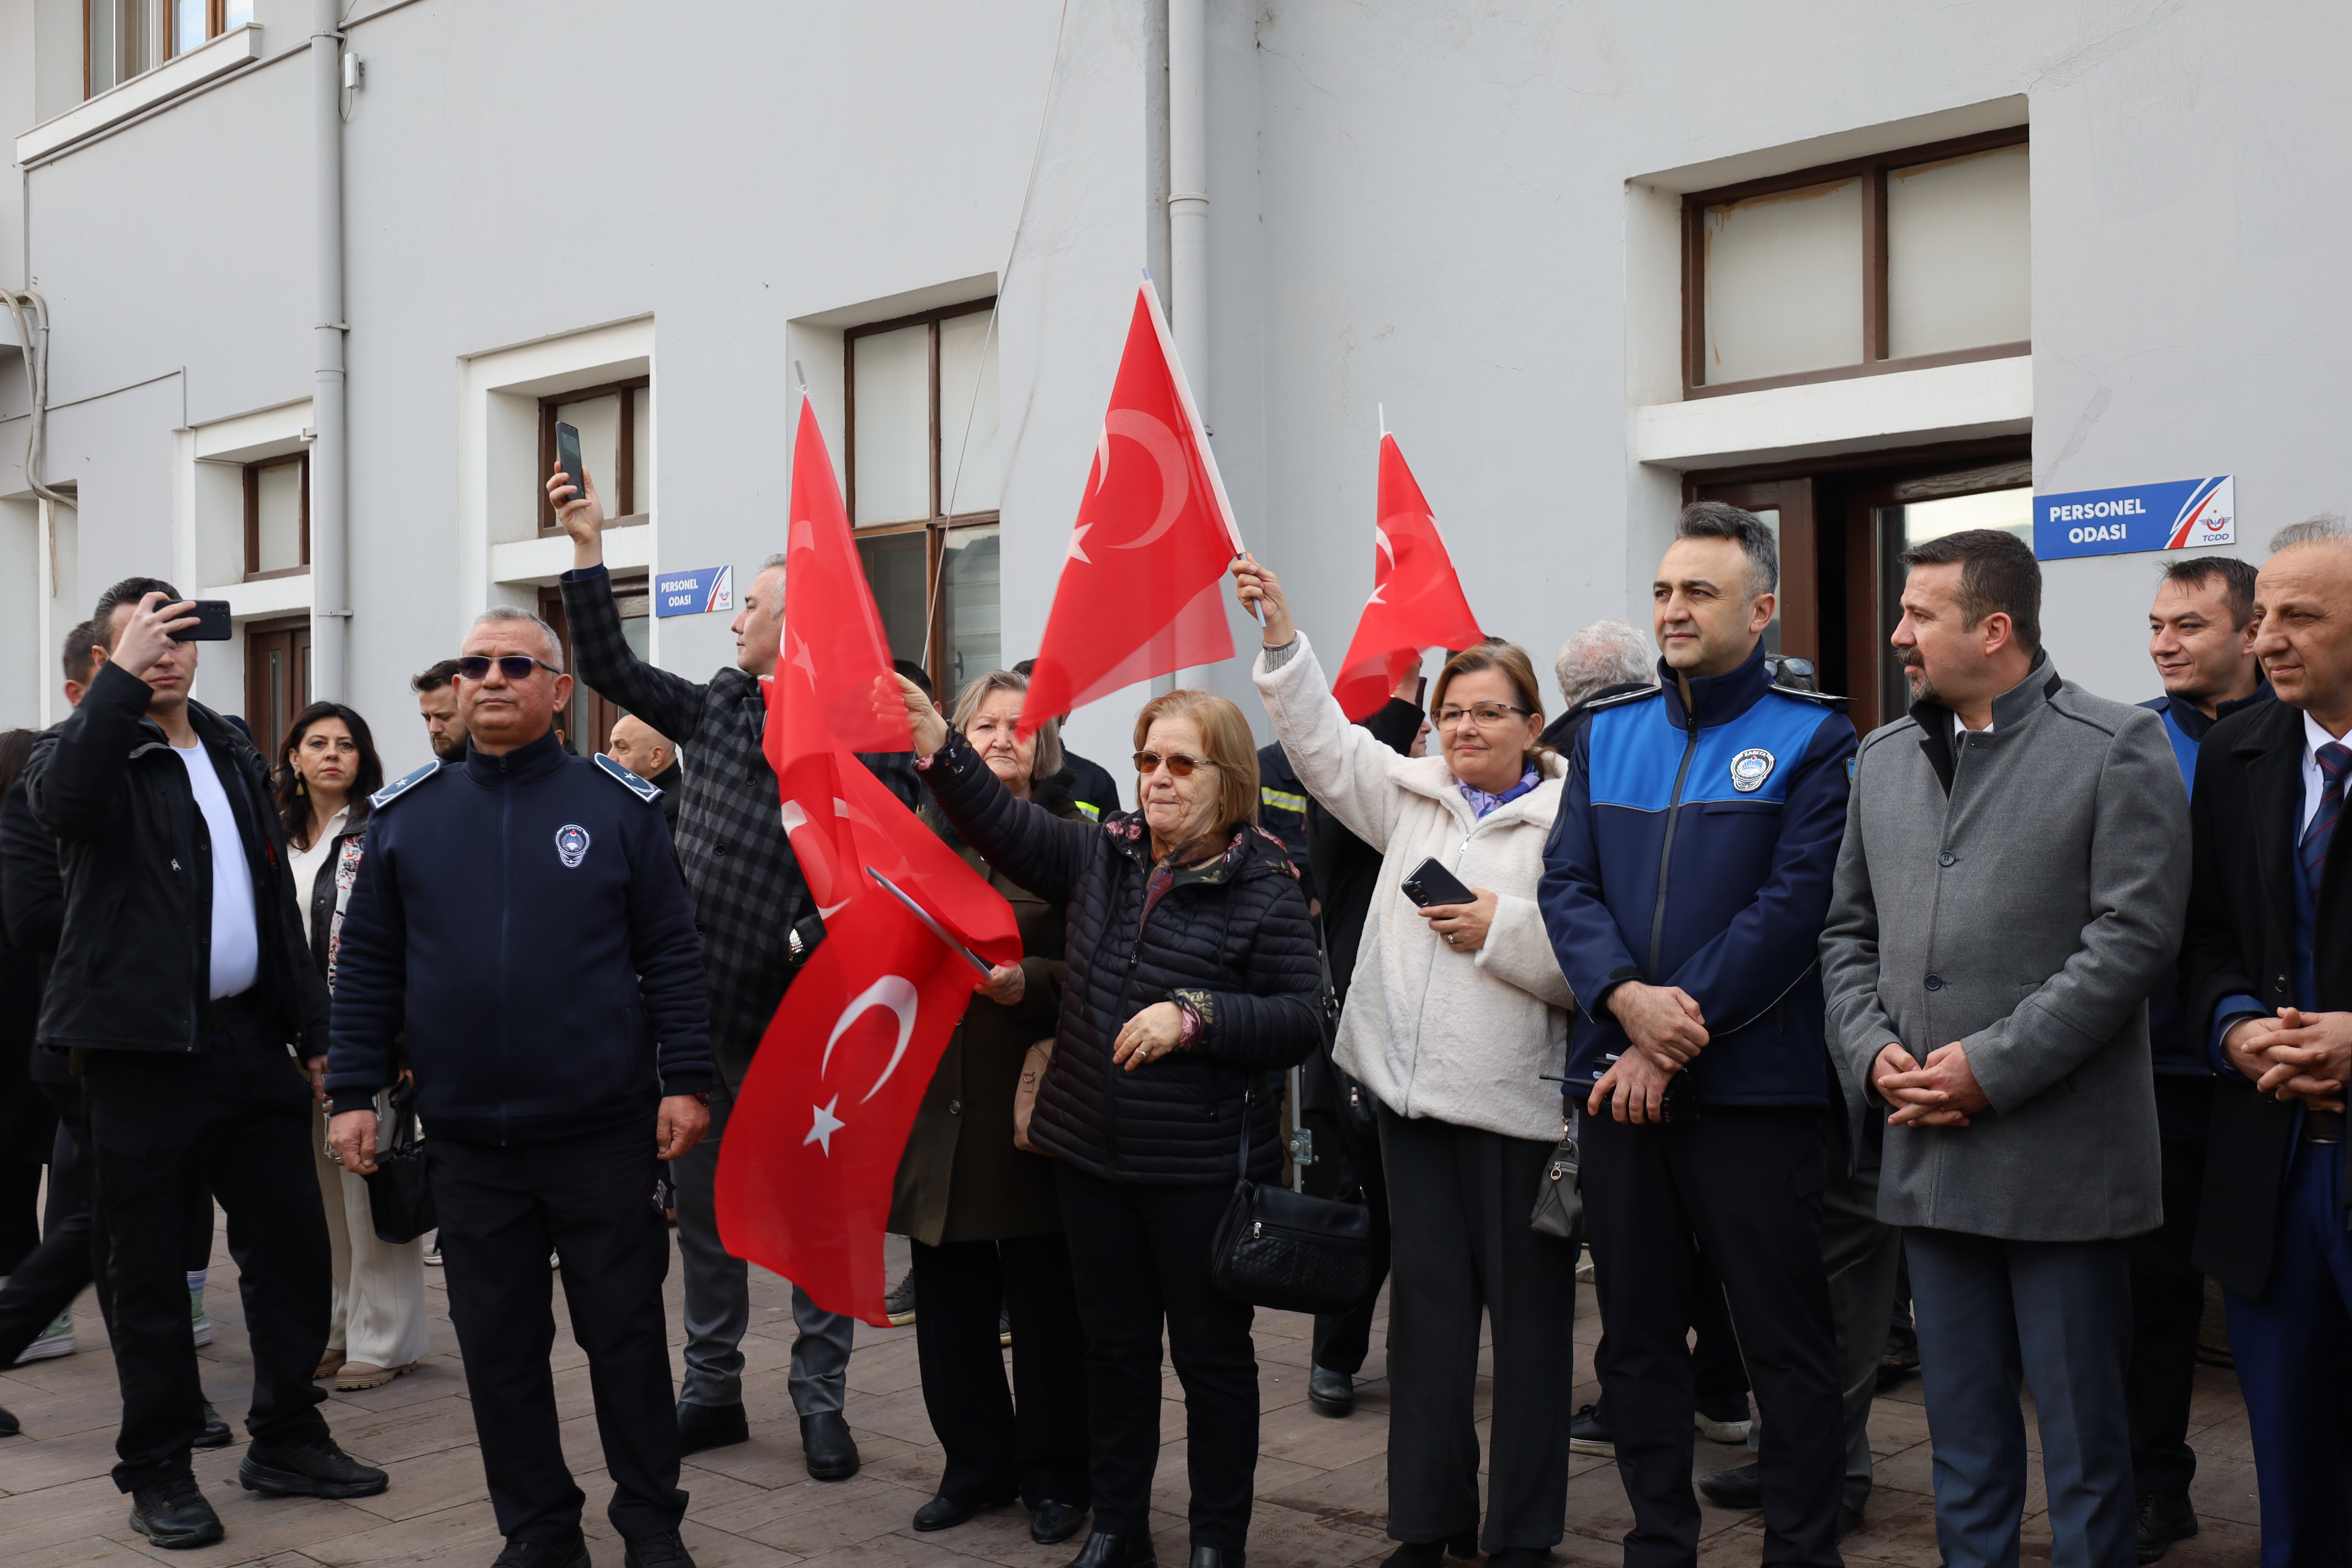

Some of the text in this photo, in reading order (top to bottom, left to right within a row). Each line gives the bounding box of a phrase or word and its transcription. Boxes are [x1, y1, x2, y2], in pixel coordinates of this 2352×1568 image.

[2049, 498, 2146, 522] PERSONEL
[2069, 524, 2126, 544] ODASI
[2202, 533, 2229, 542] TCDD
[661, 578, 698, 593] PERSONEL
[668, 594, 691, 607] ODASI
